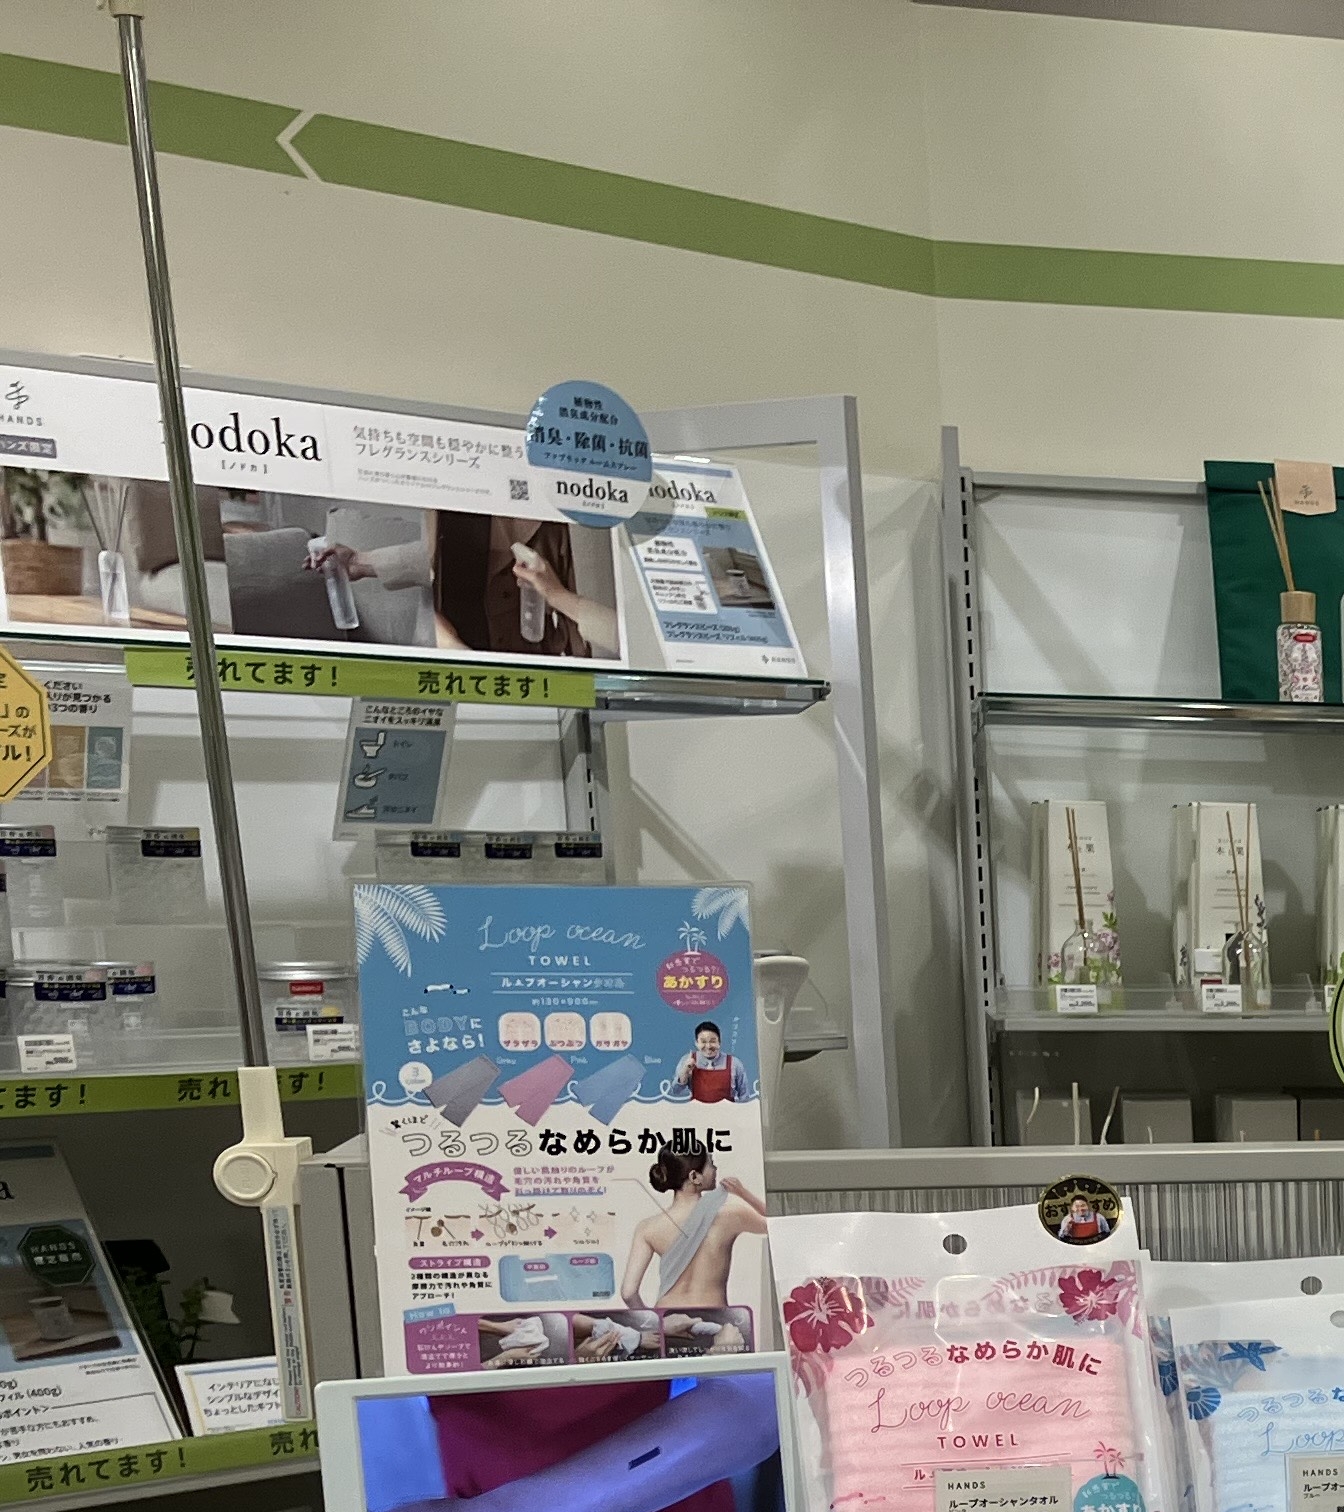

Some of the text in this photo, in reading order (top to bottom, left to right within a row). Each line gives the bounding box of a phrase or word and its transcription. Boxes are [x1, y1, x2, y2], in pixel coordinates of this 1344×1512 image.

[557, 478, 629, 503] nodoka
[418, 670, 551, 699] 売れてます！
[478, 915, 646, 952] Loop ocean
[528, 955, 592, 967] TOWEL
[663, 974, 724, 990] あかすり
[407, 1034, 485, 1055] さよなら！
[402, 1127, 733, 1158] つるつるなめらか肌に
[843, 1338, 1103, 1389] つるつるなめらか肌に
[868, 1387, 1092, 1434] Loop ocean
[936, 1433, 1020, 1450] TOWEL
[26, 1446, 187, 1492] 売れてます！
[1302, 1467, 1339, 1477] HANDS
[947, 1481, 987, 1490] HANDS
[948, 1494, 1059, 1510] ループオーシャンタオル
